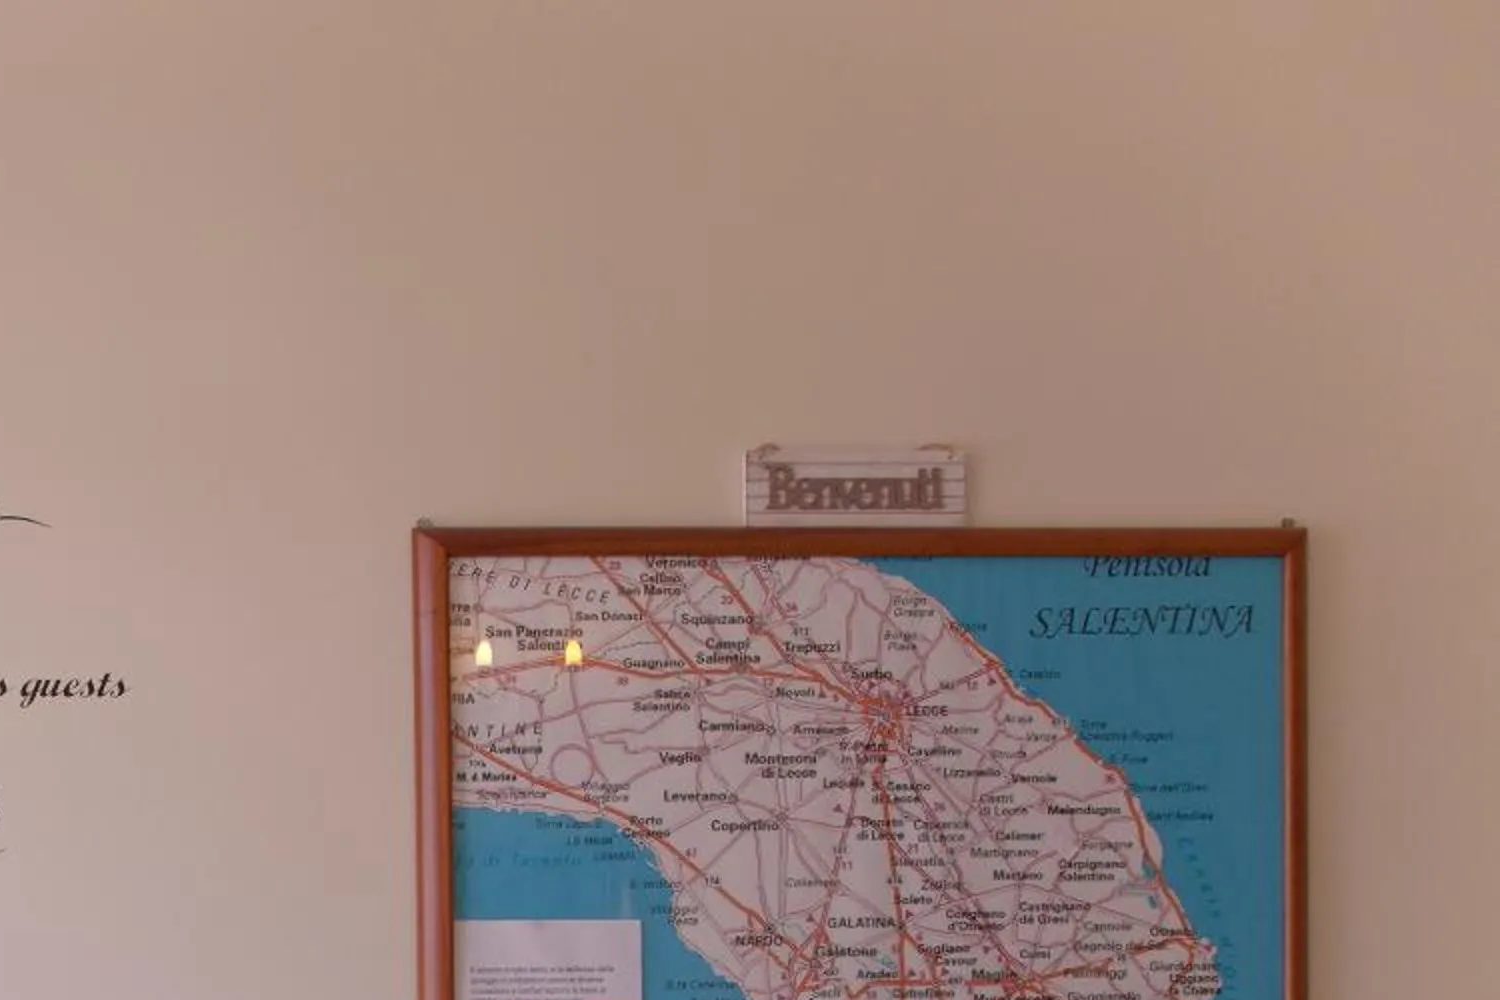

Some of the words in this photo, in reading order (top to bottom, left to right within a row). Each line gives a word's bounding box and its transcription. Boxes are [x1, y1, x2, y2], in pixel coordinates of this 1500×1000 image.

[764, 463, 946, 511] Benvenuti
[1029, 604, 1256, 638] SALENTINA
[19, 673, 130, 707] guests
[711, 819, 780, 832] Copertino
[827, 917, 897, 929] GALATINA
